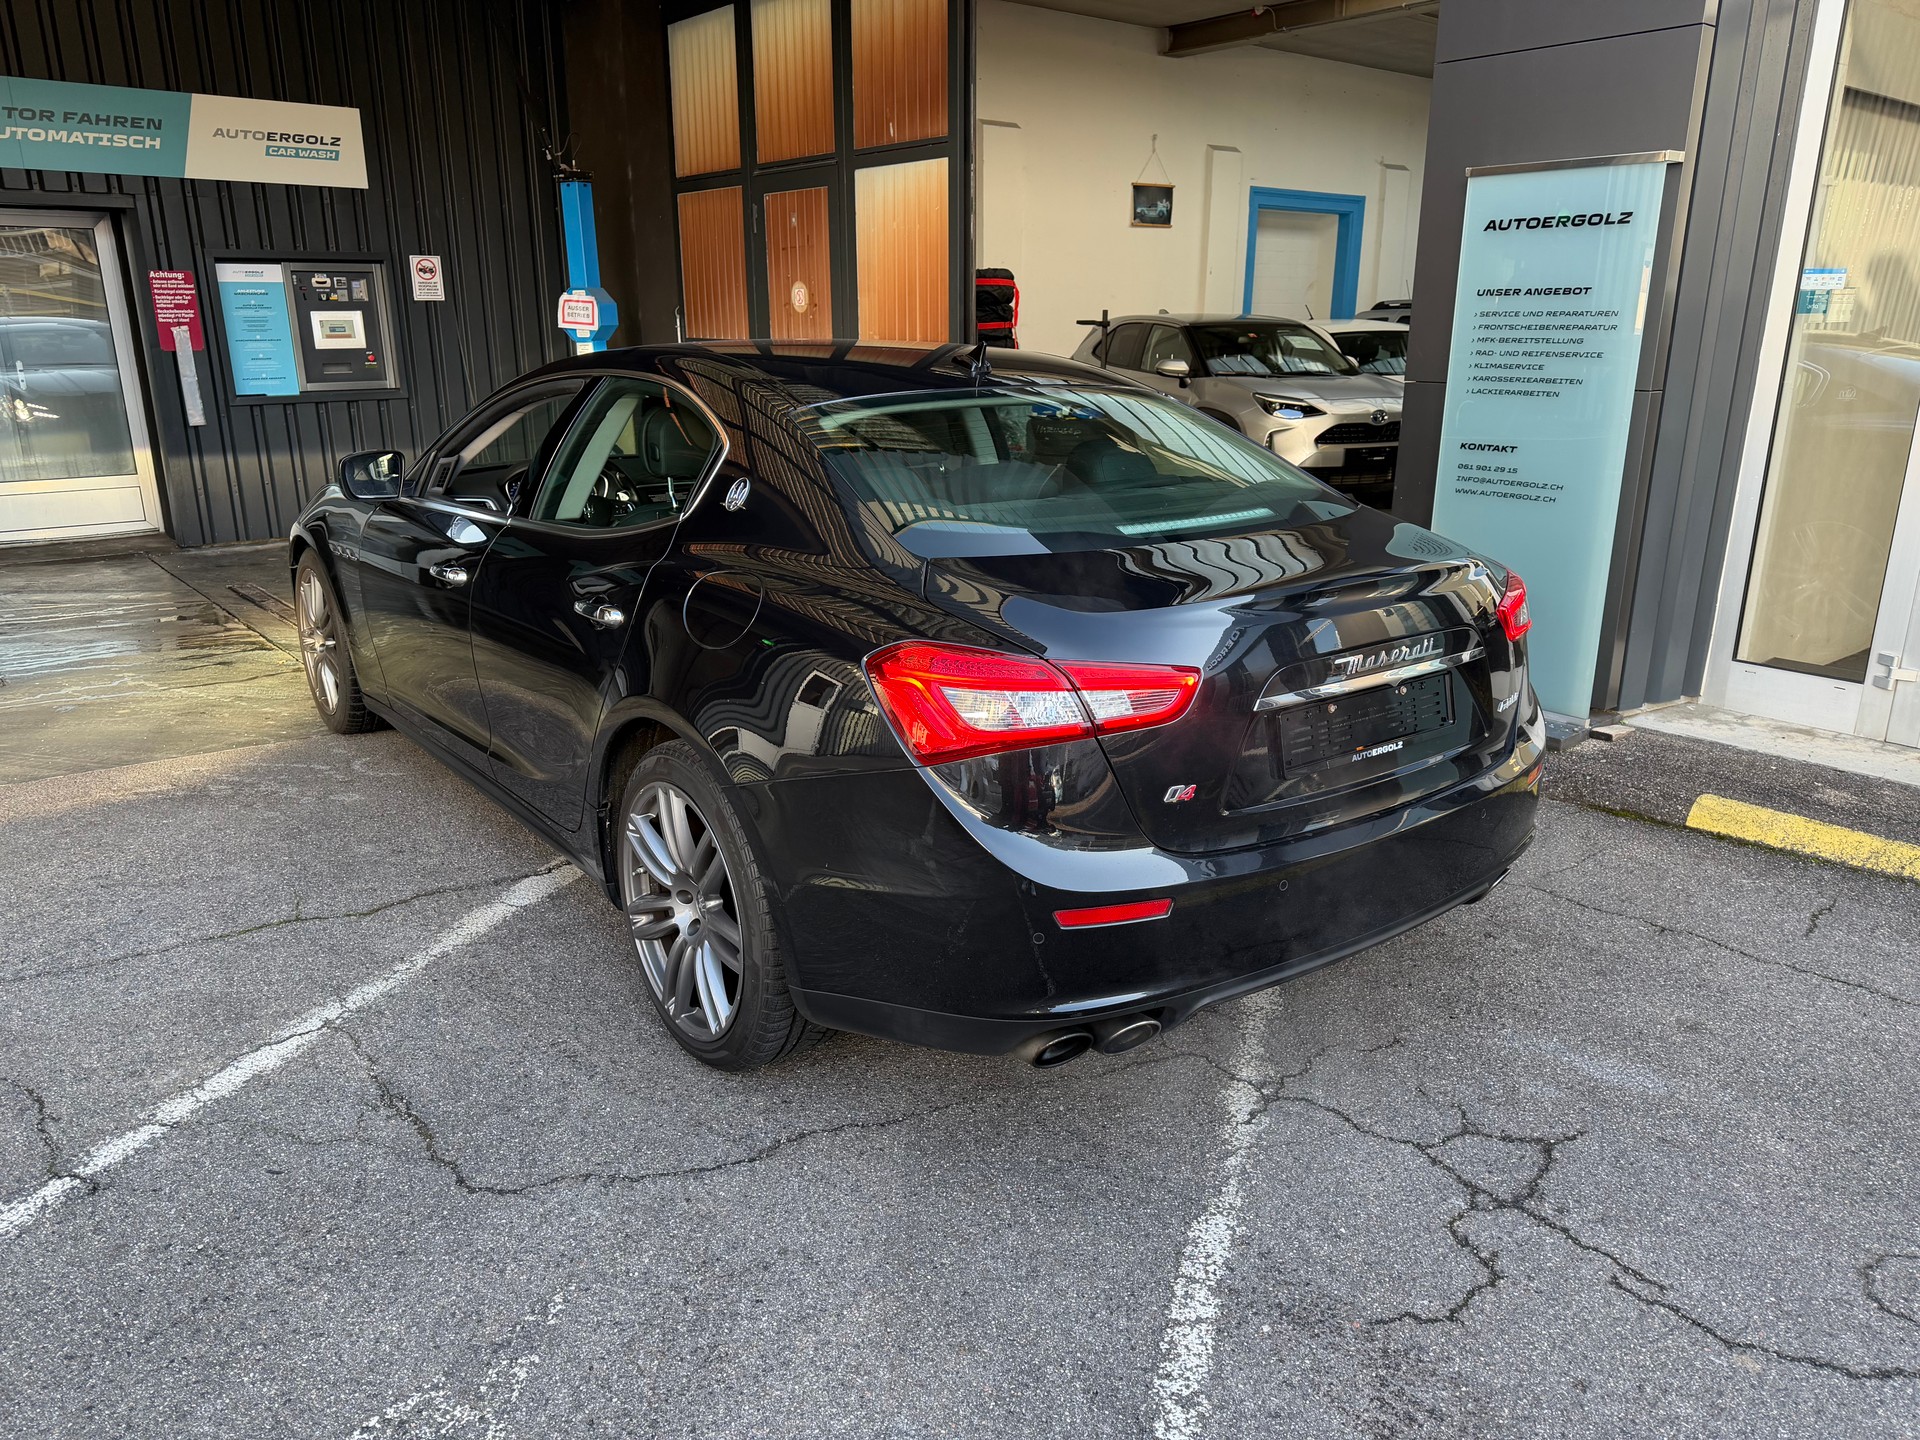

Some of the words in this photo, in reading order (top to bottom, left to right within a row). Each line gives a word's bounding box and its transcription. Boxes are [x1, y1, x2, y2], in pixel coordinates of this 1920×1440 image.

[2, 106, 55, 122] TOR
[62, 111, 162, 130] FAHREN
[212, 127, 342, 147] AUTOERGOLZ
[268, 147, 296, 156] CAR
[298, 149, 336, 160] WASH
[1483, 212, 1634, 232] AUTOERGOLZ
[150, 270, 185, 280] Achtung:
[1476, 288, 1521, 297] UNSER
[1524, 287, 1592, 296] ANGEBOT
[1472, 376, 1584, 385] KAROSSERIEARBEITEN
[1471, 388, 1560, 398] LACKIERARBEITEN
[1460, 442, 1518, 453] KONTAKT
[1456, 476, 1564, 491] INFO@AUTOERGOLZ.CH
[1455, 488, 1556, 503] WWW.AUTOERGOLZ.CH
[1334, 637, 1443, 676] Maserati
[1352, 740, 1404, 762] AUTOERGOLZ
[1164, 784, 1197, 803] Q4
